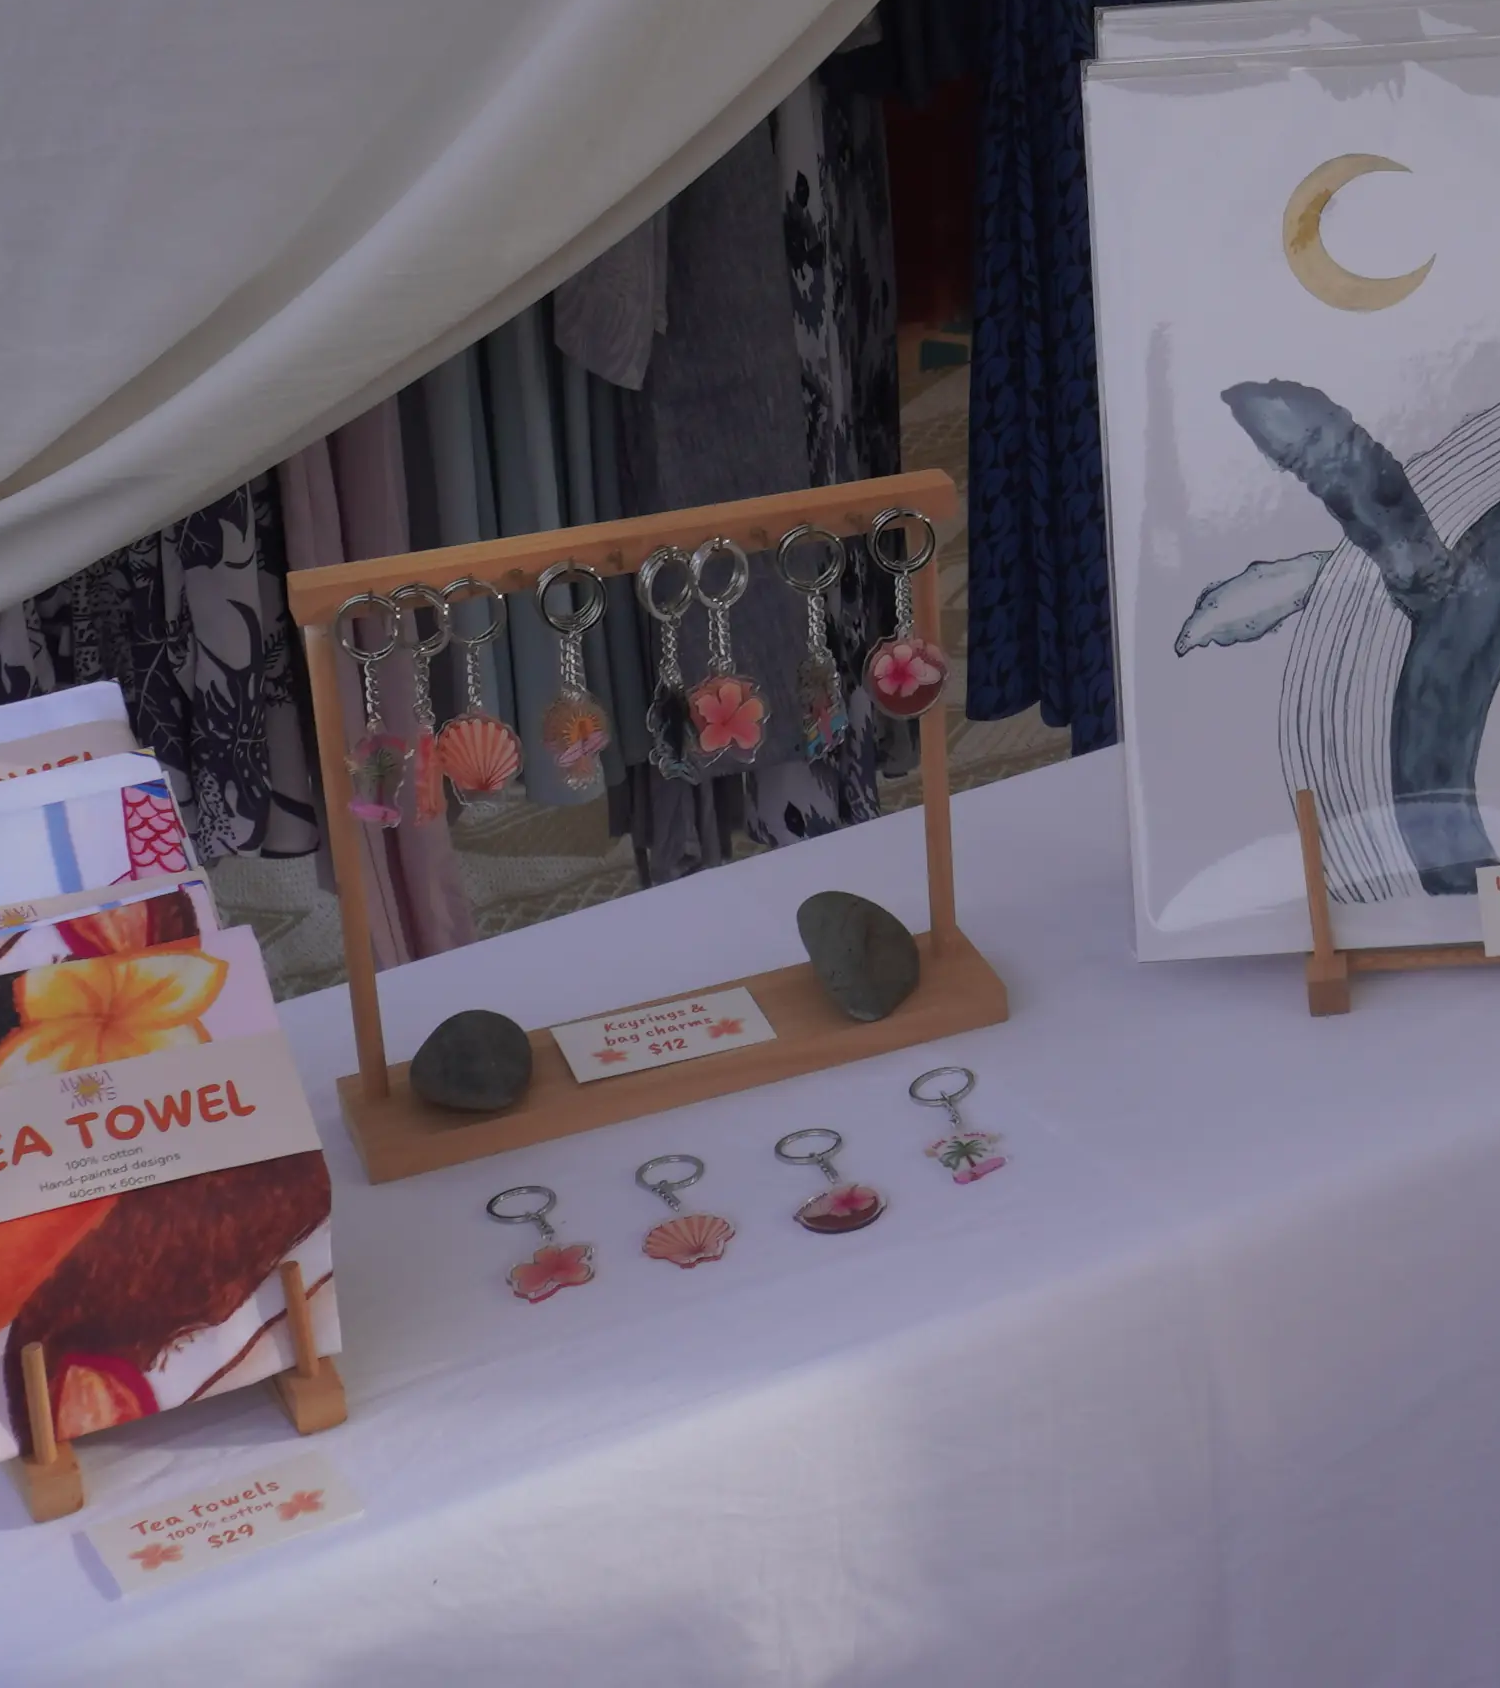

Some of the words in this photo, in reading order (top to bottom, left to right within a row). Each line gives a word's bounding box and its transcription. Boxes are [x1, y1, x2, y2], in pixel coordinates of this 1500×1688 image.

[603, 1008, 687, 1033] Keyrings
[690, 1003, 708, 1013] &
[603, 1032, 640, 1047] bag
[645, 1016, 714, 1038] charms
[647, 1037, 690, 1056] $12
[64, 1079, 257, 1149] TOWEL
[39, 1162, 129, 1193] Hand-painted
[131, 1151, 182, 1173] designs
[64, 1155, 100, 1172] 100%
[102, 1144, 144, 1164] cotton
[68, 1184, 106, 1200] 40cm
[129, 1515, 184, 1537] Tea
[188, 1480, 281, 1518] towels
[166, 1518, 217, 1541] 100%
[220, 1500, 274, 1524] cotton
[207, 1523, 256, 1549] $29
